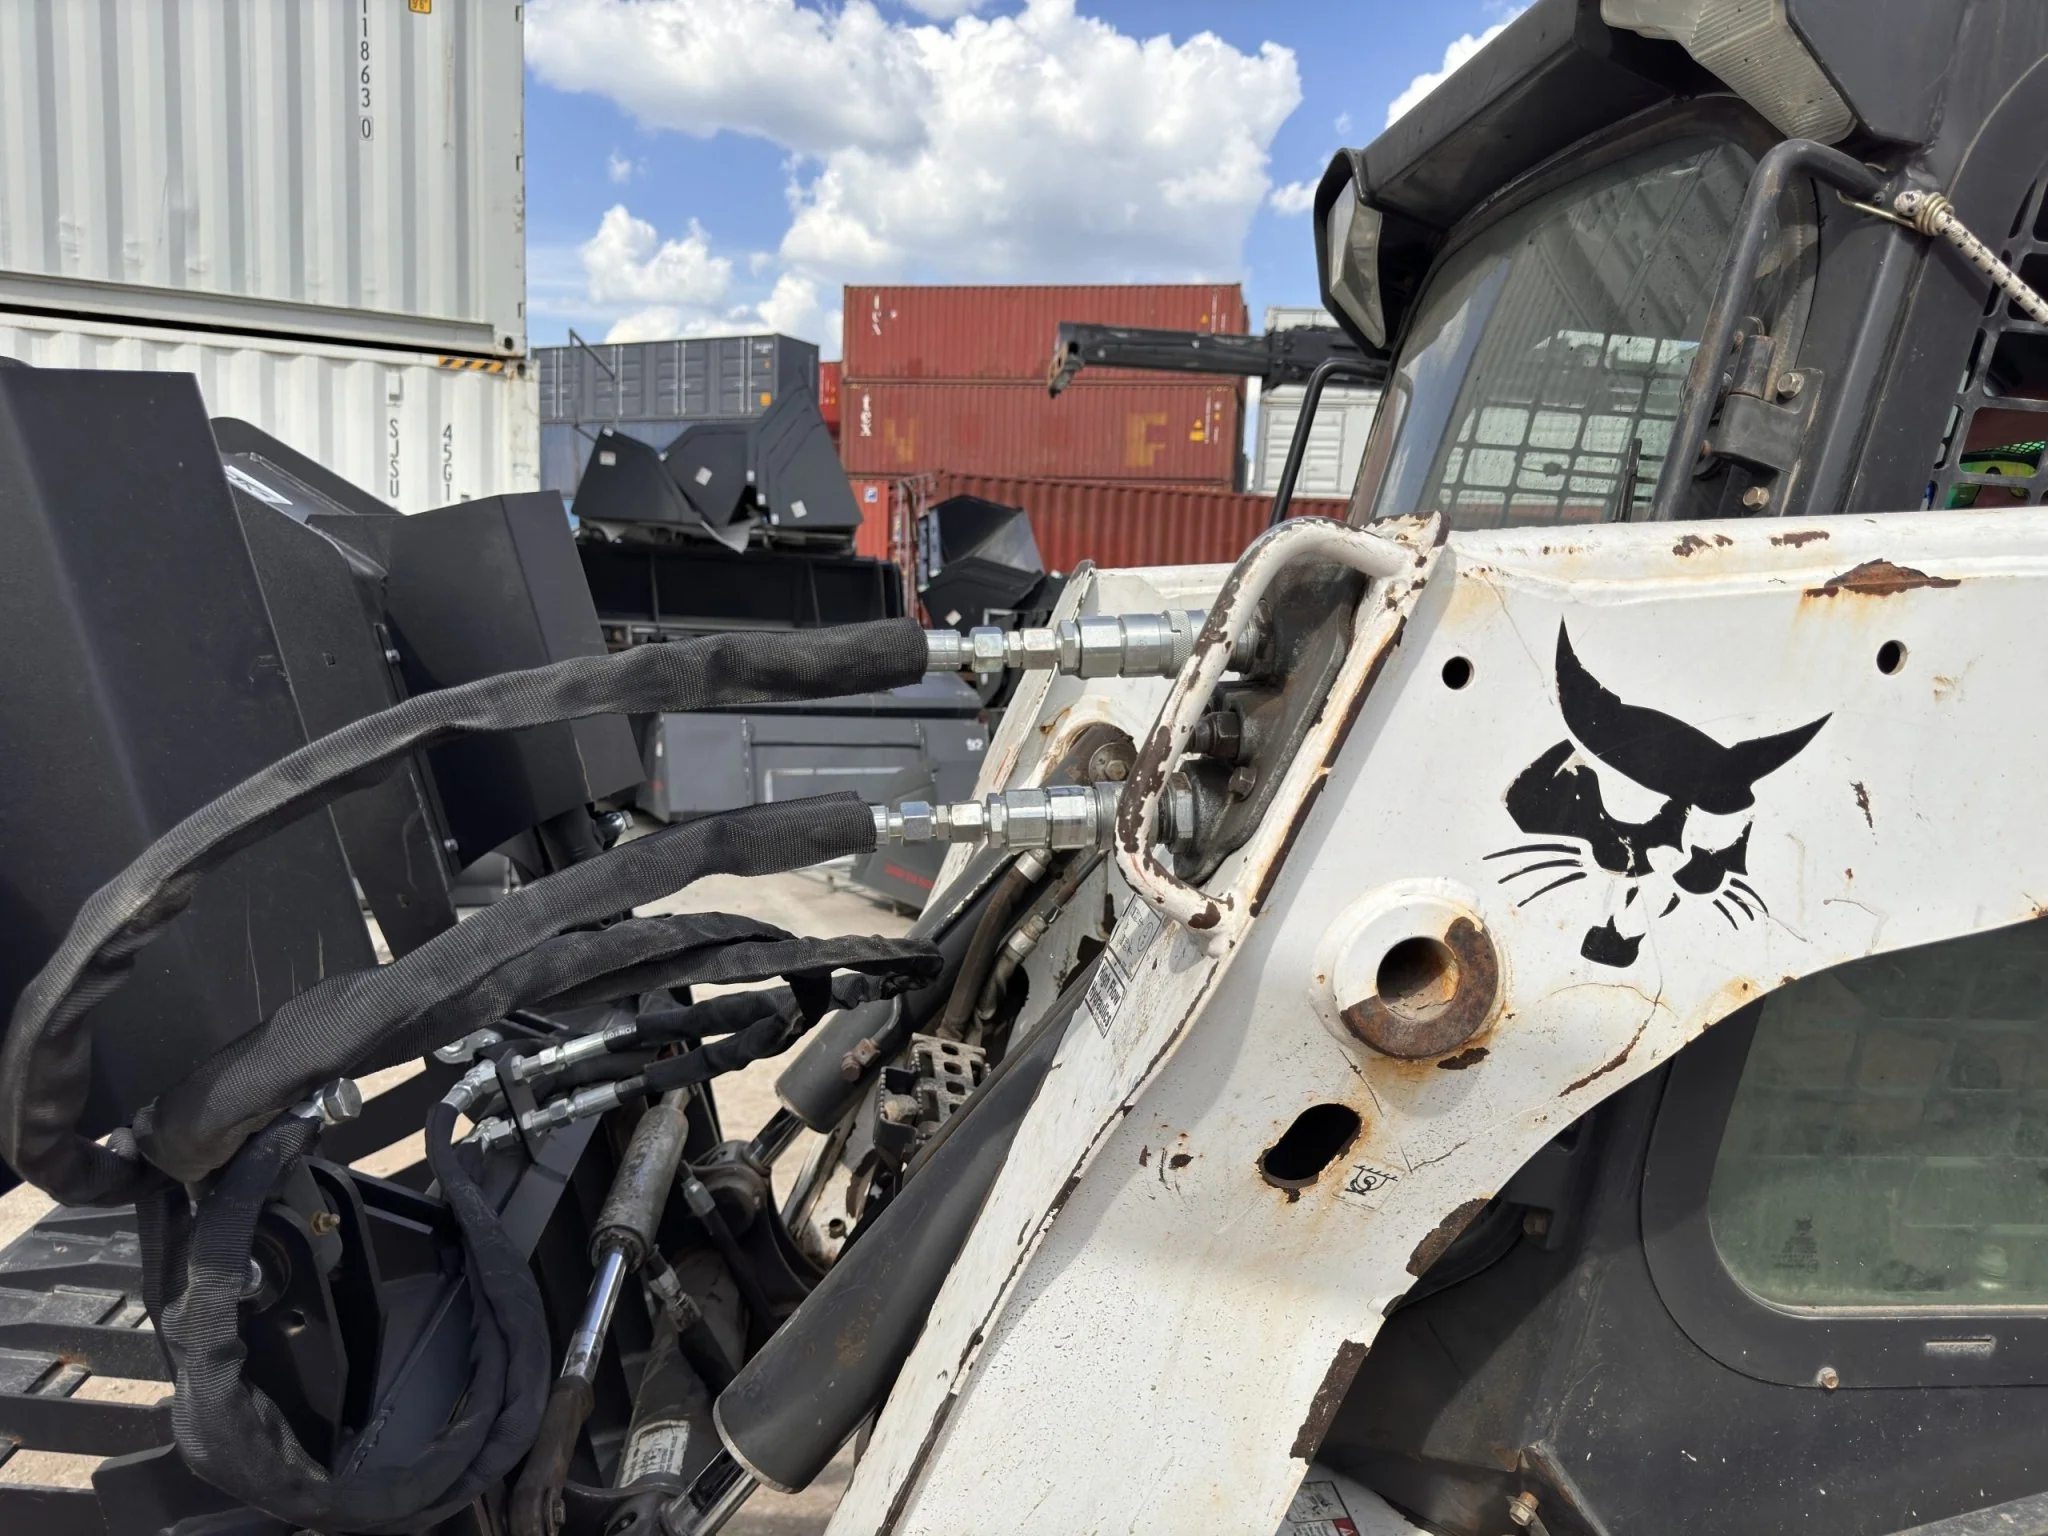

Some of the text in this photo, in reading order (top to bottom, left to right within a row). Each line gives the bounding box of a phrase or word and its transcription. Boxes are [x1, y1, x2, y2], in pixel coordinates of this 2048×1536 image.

[442, 422, 453, 502] 45G1
[1088, 980, 1112, 1028] Hydraulics
[1098, 963, 1121, 1006] High Flow
